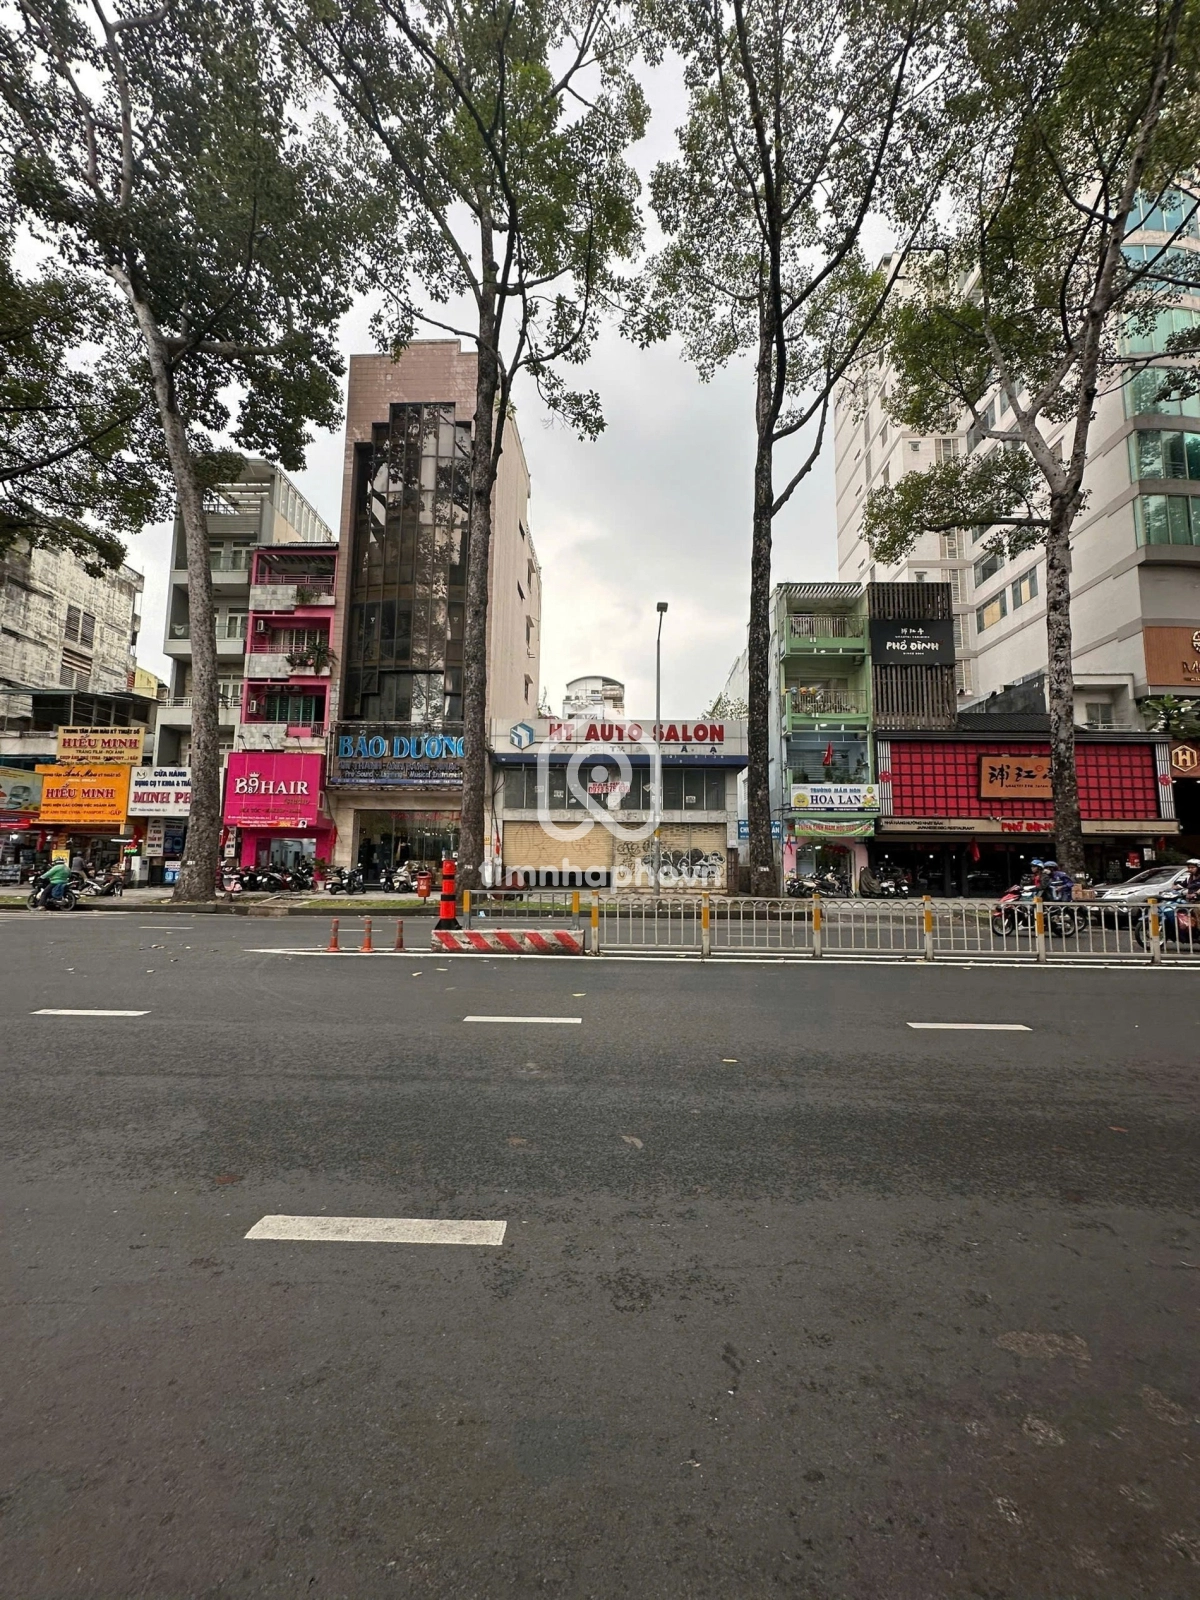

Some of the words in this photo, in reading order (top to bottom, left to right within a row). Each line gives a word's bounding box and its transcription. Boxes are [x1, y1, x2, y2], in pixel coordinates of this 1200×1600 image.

[886, 640, 908, 650] PHỔ
[910, 640, 940, 650] ĐÌNH
[550, 724, 574, 740] HT
[585, 724, 642, 741] AUTO
[653, 724, 724, 741] SALON
[62, 734, 98, 748] HIỂU
[101, 738, 140, 748] MINH
[338, 730, 386, 758] BẢO
[154, 769, 167, 777] CỬA
[46, 783, 78, 798] HIỂU
[81, 788, 115, 798] MINH
[132, 792, 170, 804] MINH
[810, 795, 834, 804] HOA
[838, 795, 861, 804] LAN
